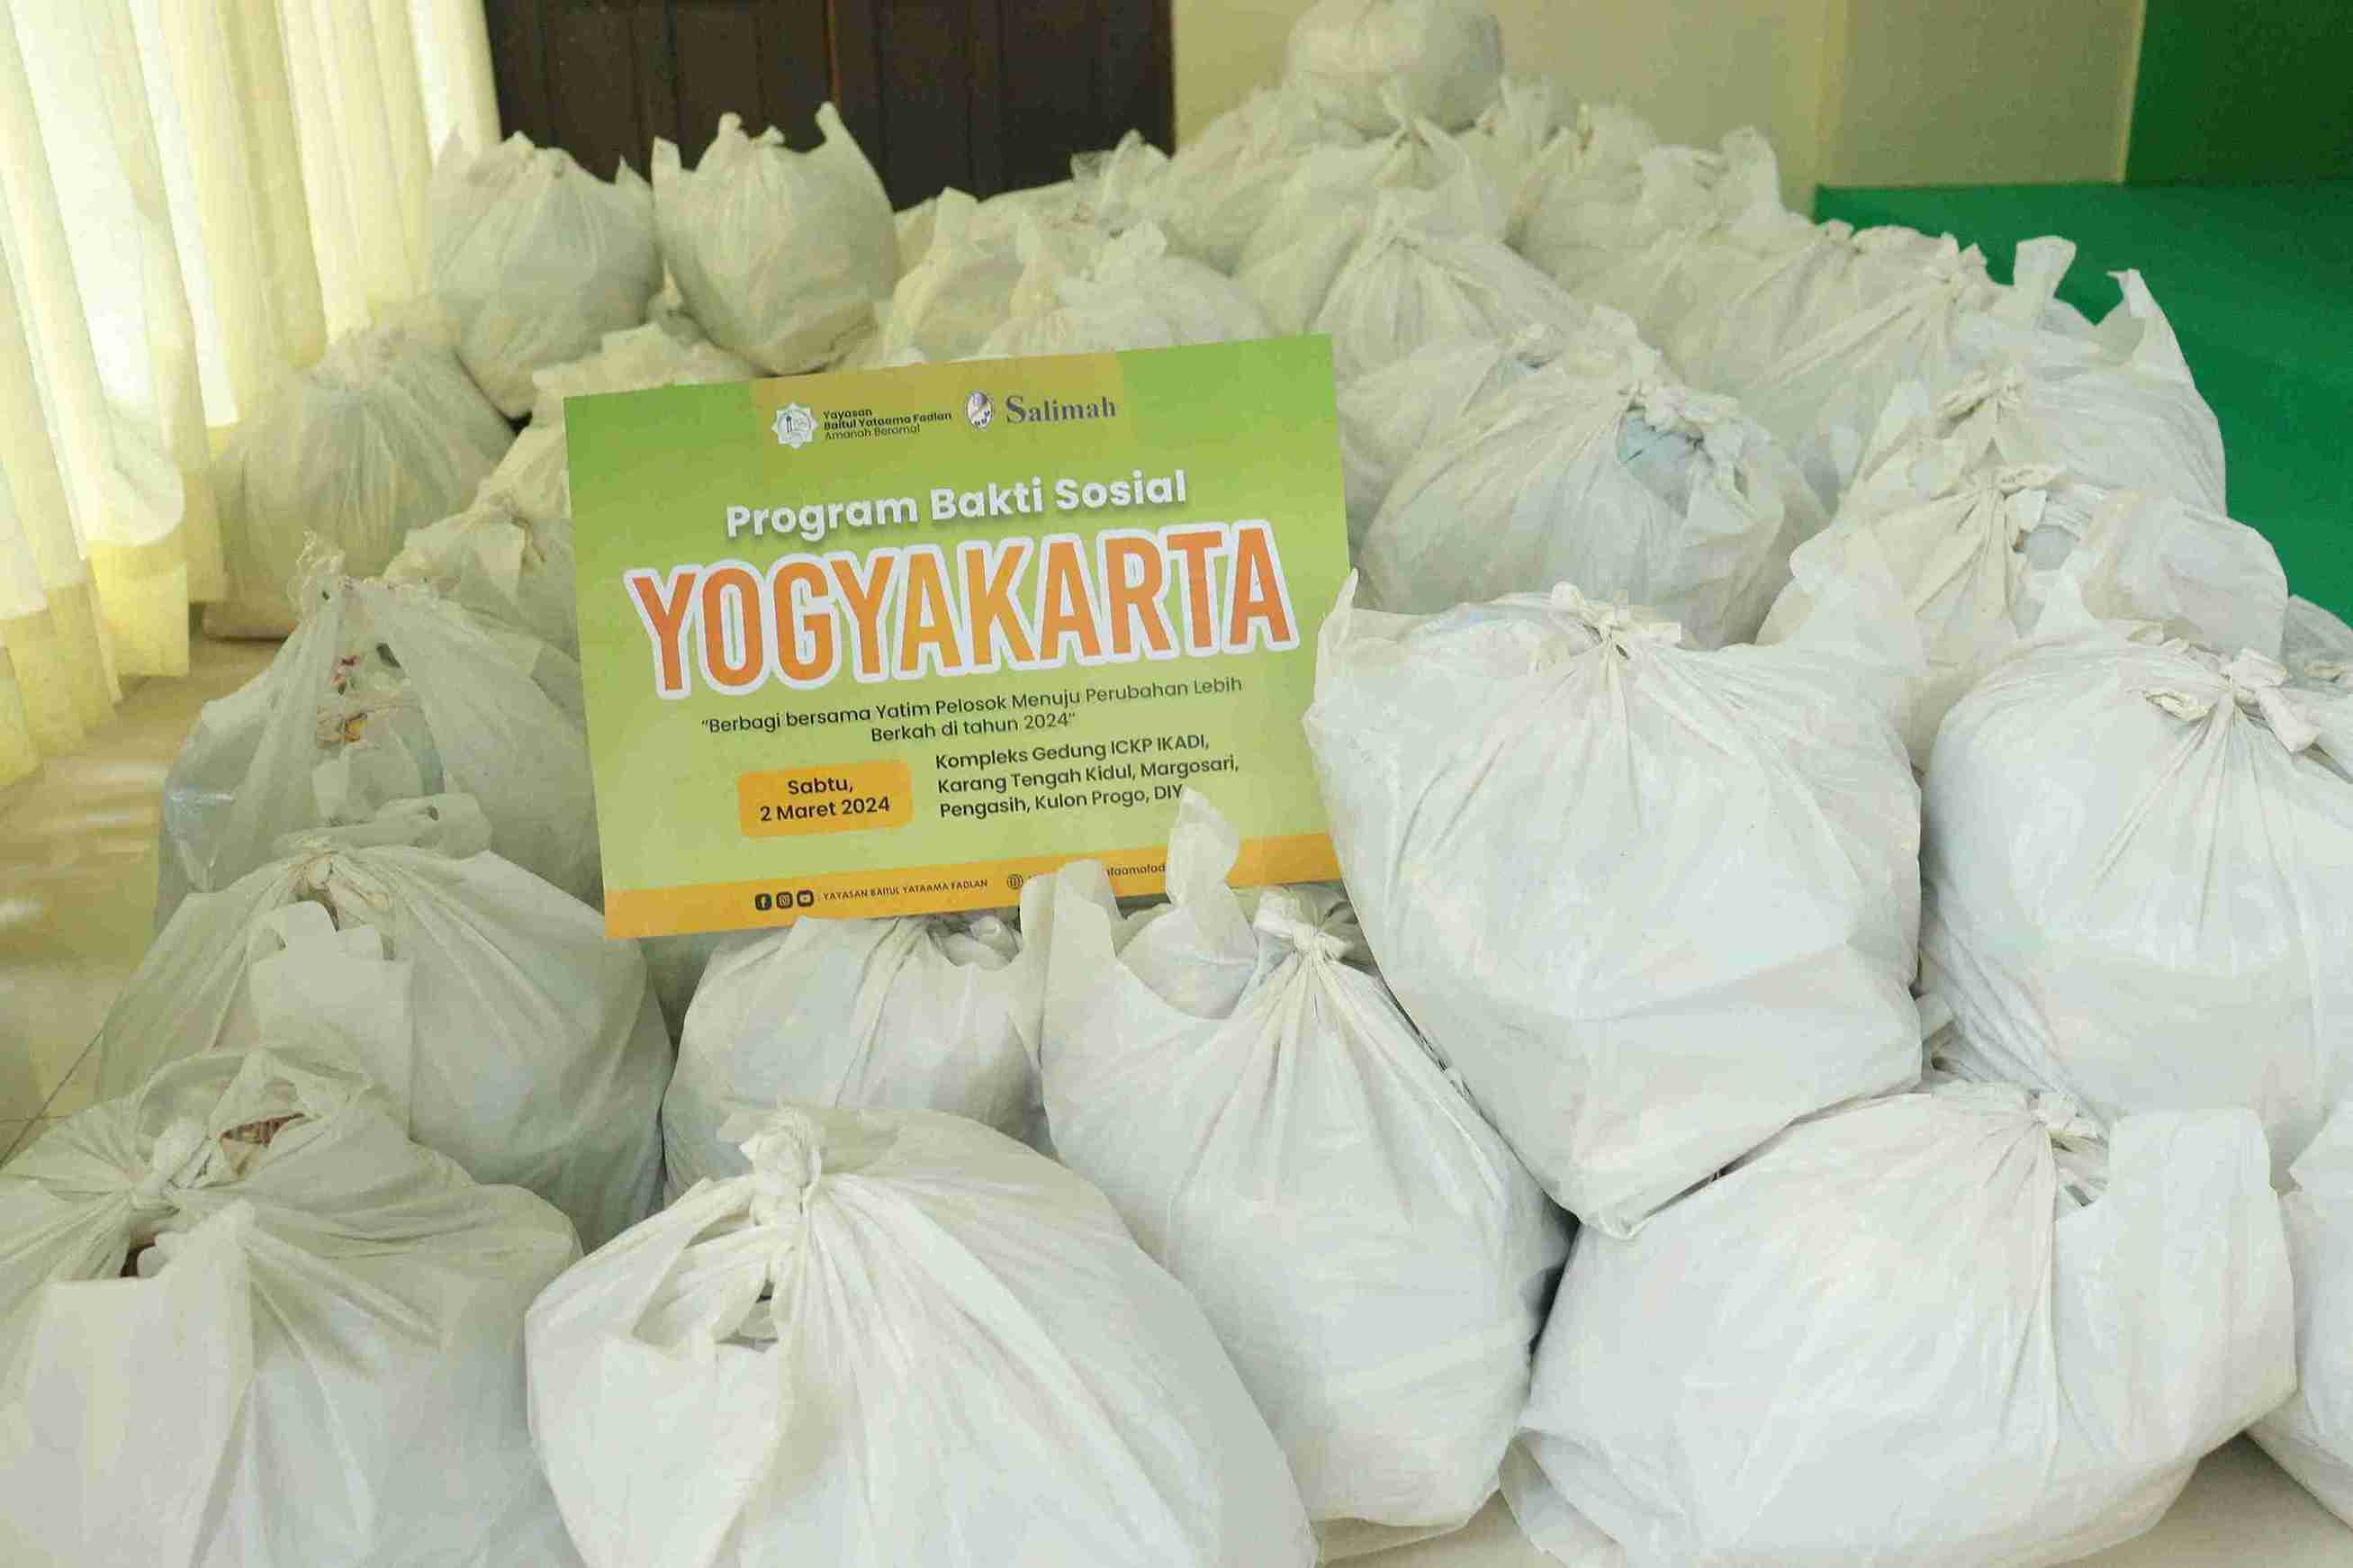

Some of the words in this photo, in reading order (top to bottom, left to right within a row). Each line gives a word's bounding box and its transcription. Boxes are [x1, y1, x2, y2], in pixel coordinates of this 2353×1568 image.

[823, 408, 872, 419] Yayasan
[824, 419, 857, 430] Baitul
[859, 414, 912, 428] Yataama
[1005, 394, 1116, 424] Salimah
[825, 427, 872, 440] Amanah
[874, 423, 920, 437] Beramal
[726, 497, 918, 538] Program
[931, 479, 1041, 517] Bakti
[1055, 470, 1187, 509] Sosial
[623, 519, 1300, 698] YOGYAKARTA
[701, 712, 780, 734] "Berbagi
[787, 706, 871, 727] bersama
[876, 700, 931, 721] Yatim
[935, 695, 1006, 716] Pelosok
[1011, 689, 1080, 712] Menuju
[1088, 682, 1193, 703] Perubahan
[1194, 677, 1242, 696] Lebih
[870, 723, 936, 743] Berkah
[941, 721, 958, 738] di
[962, 716, 1019, 735] tahun
[1023, 710, 1076, 731] 2024"
[935, 750, 1029, 771] Kompleks
[1032, 740, 1106, 764] Gedung
[1110, 735, 1152, 755] ICKP
[1158, 733, 1210, 753] IKADI,
[788, 775, 854, 796] Sabtu,
[938, 777, 1006, 797] Karang
[1010, 767, 1080, 791] Tengah
[1085, 763, 1136, 783] Kidul,
[1140, 753, 1240, 779] Margosari,
[760, 806, 771, 823] 2
[776, 801, 836, 822] Maret
[842, 796, 890, 816] 2024
[940, 797, 1031, 822] Pengasih,
[1035, 790, 1087, 811] Kulon
[1093, 789, 1153, 808] Progo,
[823, 888, 870, 902] YAYASAN
